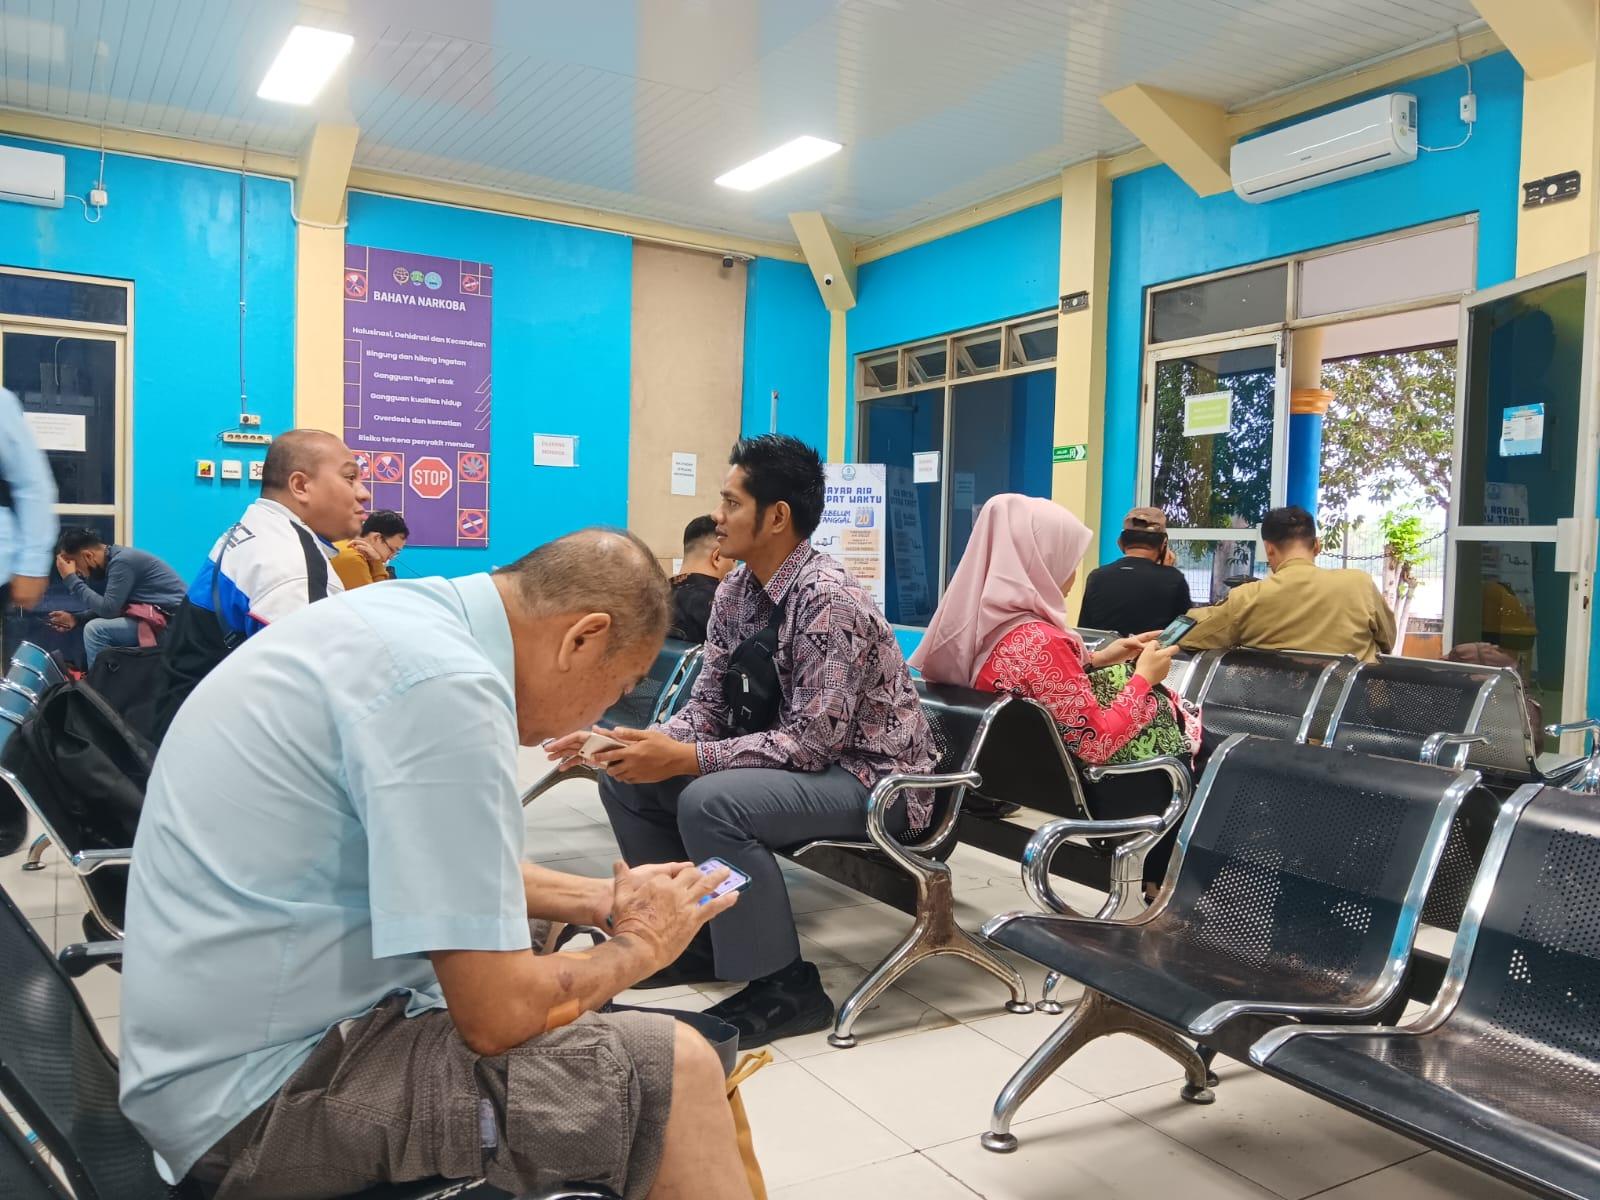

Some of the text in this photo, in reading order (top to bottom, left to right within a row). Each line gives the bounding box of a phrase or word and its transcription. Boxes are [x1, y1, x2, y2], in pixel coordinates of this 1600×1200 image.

[373, 291, 466, 311] BAHAYA NARKOBA
[394, 331, 430, 341] Dehidrasi
[430, 335, 445, 343] dan
[445, 337, 486, 348] Kecanduan
[366, 350, 398, 360] Bingung
[398, 352, 413, 360] dan
[414, 354, 437, 364] hilang
[373, 371, 413, 381] Gangguan
[413, 375, 437, 384] fungsi
[370, 392, 462, 408] Gangguan kualitas hidup
[373, 414, 462, 427] Overdosis dan kematian
[358, 434, 475, 449] Risiko terkena penyakit menular
[414, 470, 448, 486] STOP
[826, 495, 845, 503] PAT
[849, 495, 882, 504] WAKTU
